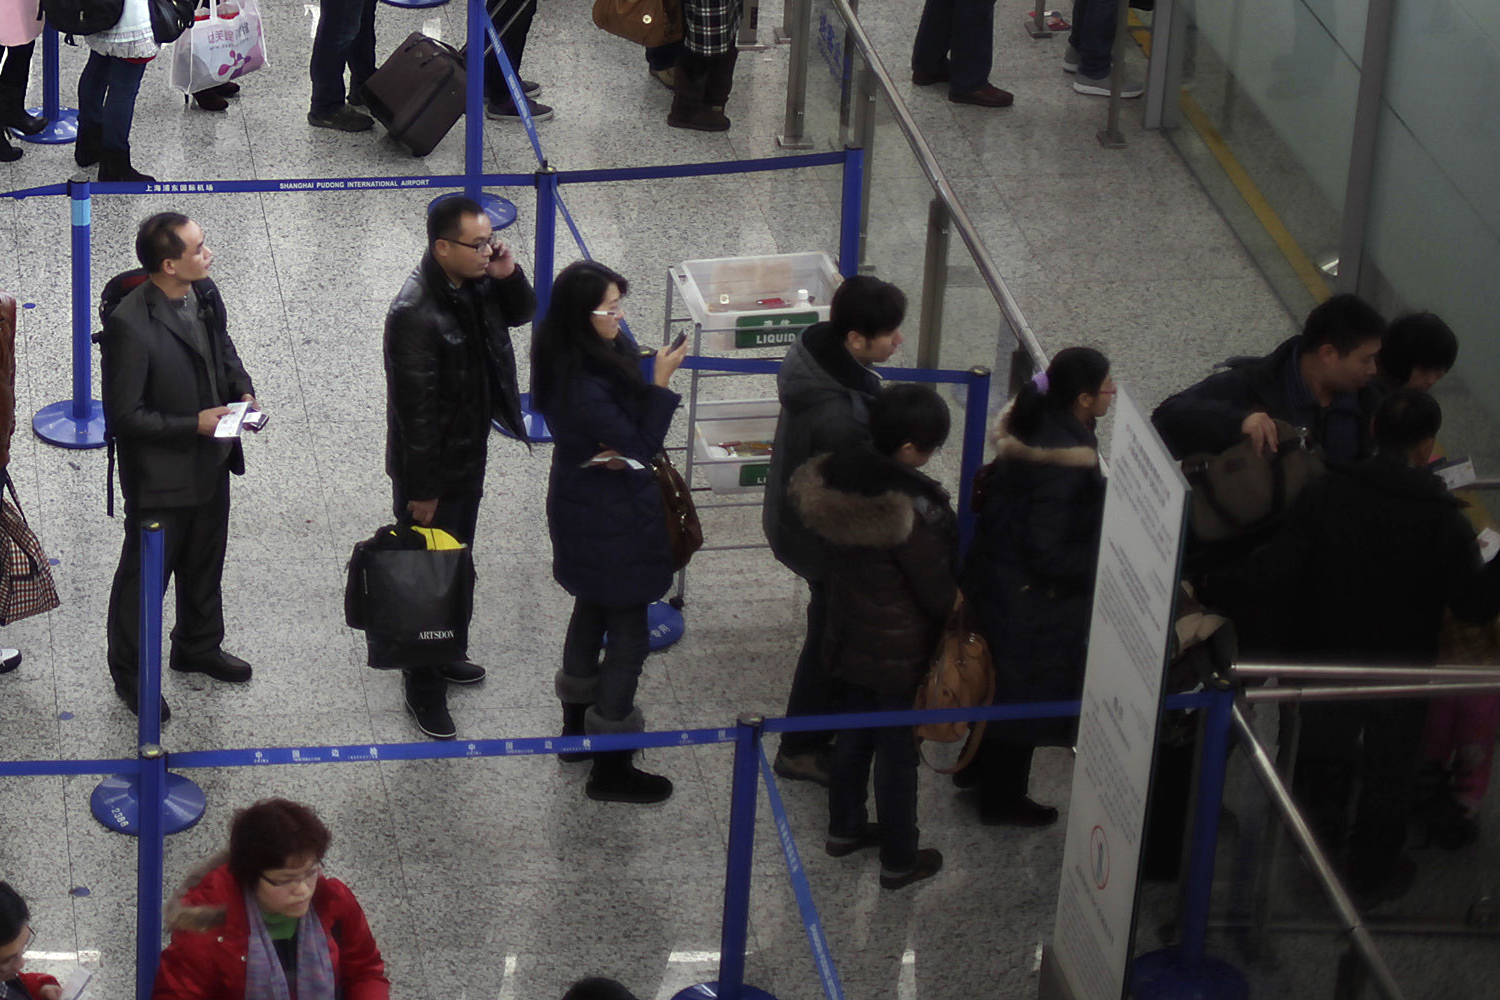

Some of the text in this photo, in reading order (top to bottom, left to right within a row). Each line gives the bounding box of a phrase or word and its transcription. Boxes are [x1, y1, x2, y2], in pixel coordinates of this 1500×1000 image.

[145, 183, 214, 193] 上海浦东国际机场
[279, 177, 430, 190] SHANGHAI PUDONG INTERNATIONAL AIRPORT
[756, 332, 796, 345] LIQUID
[418, 630, 455, 640] ARTSDON
